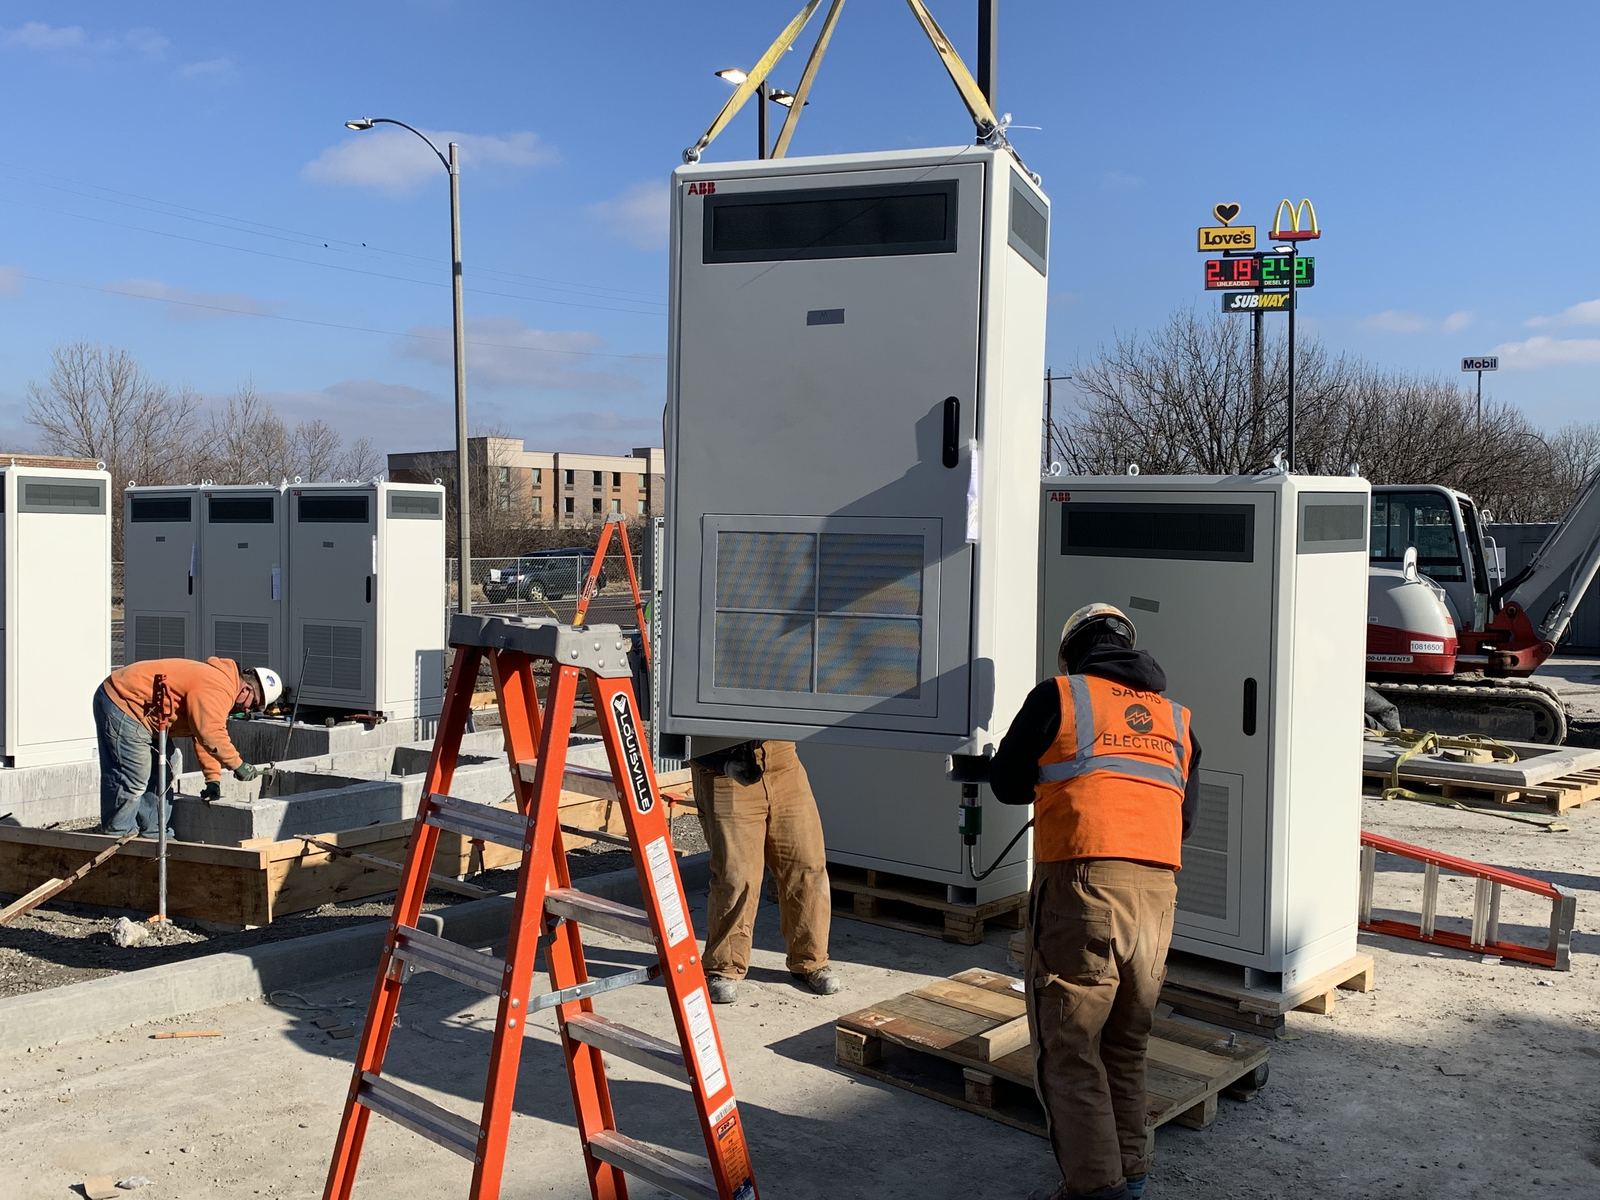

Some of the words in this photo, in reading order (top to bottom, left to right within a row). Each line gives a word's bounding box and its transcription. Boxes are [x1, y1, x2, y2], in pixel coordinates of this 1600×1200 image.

[688, 180, 716, 195] ABB
[1204, 231, 1251, 245] Love's
[1230, 293, 1290, 309] SUBWAY
[1463, 358, 1497, 370] Mobil
[1050, 493, 1071, 502] ABB
[1102, 733, 1173, 754] ELECTRIC
[619, 713, 651, 811] LOUISVILLE
